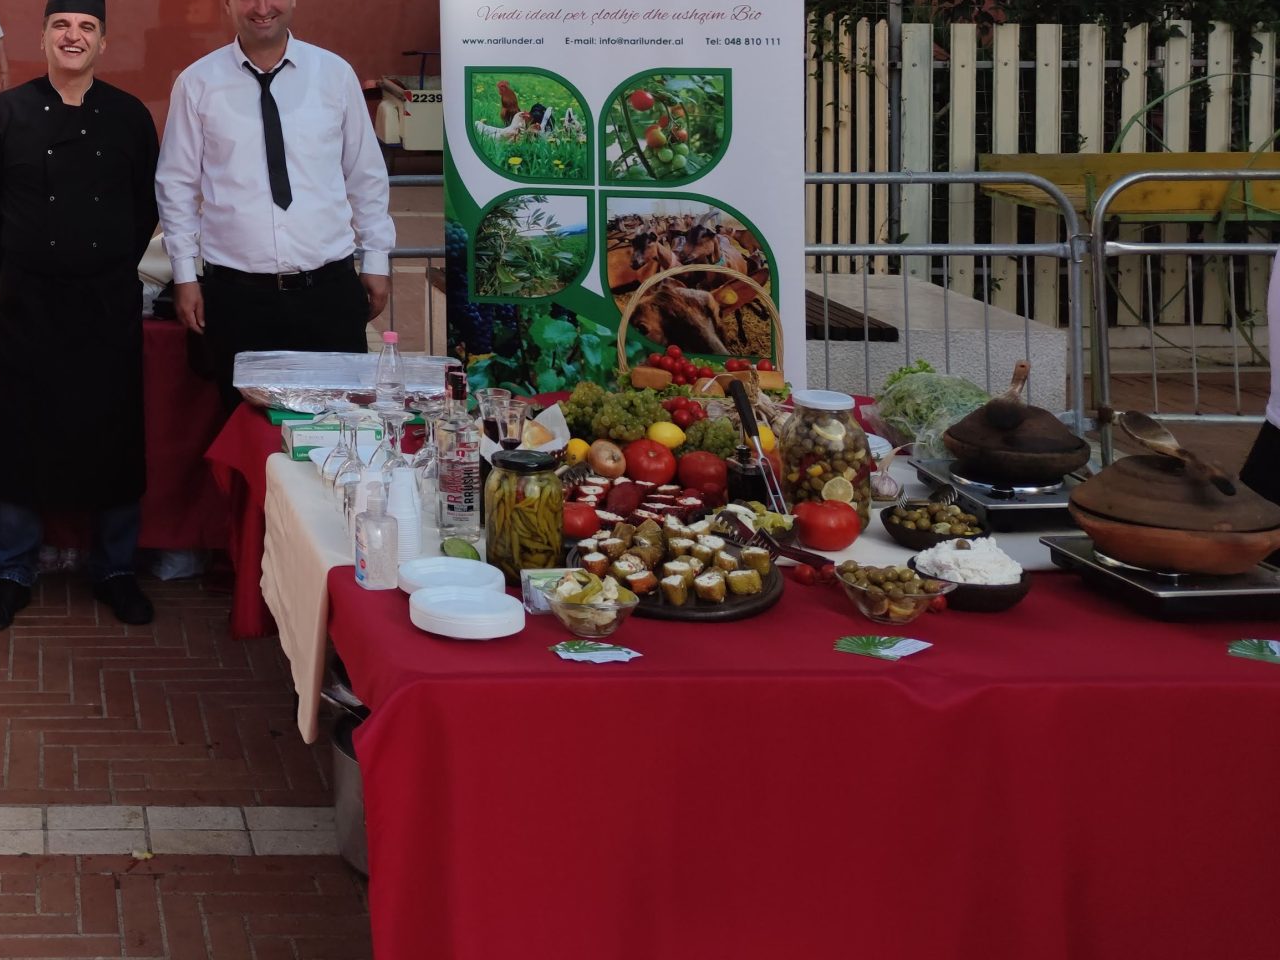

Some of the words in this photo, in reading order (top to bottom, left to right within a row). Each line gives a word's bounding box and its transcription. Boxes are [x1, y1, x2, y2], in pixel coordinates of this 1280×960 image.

[477, 5, 523, 21] Vendi
[525, 8, 562, 20] ideal
[642, 8, 669, 20] dhe
[730, 5, 762, 21] Bio
[565, 37, 597, 45] E-mail:
[705, 37, 721, 45] Tel:
[724, 37, 742, 46] 048
[744, 37, 762, 46] 810
[765, 37, 781, 46] 111
[412, 93, 442, 103] 2239
[464, 469, 474, 504] RRUSHI
